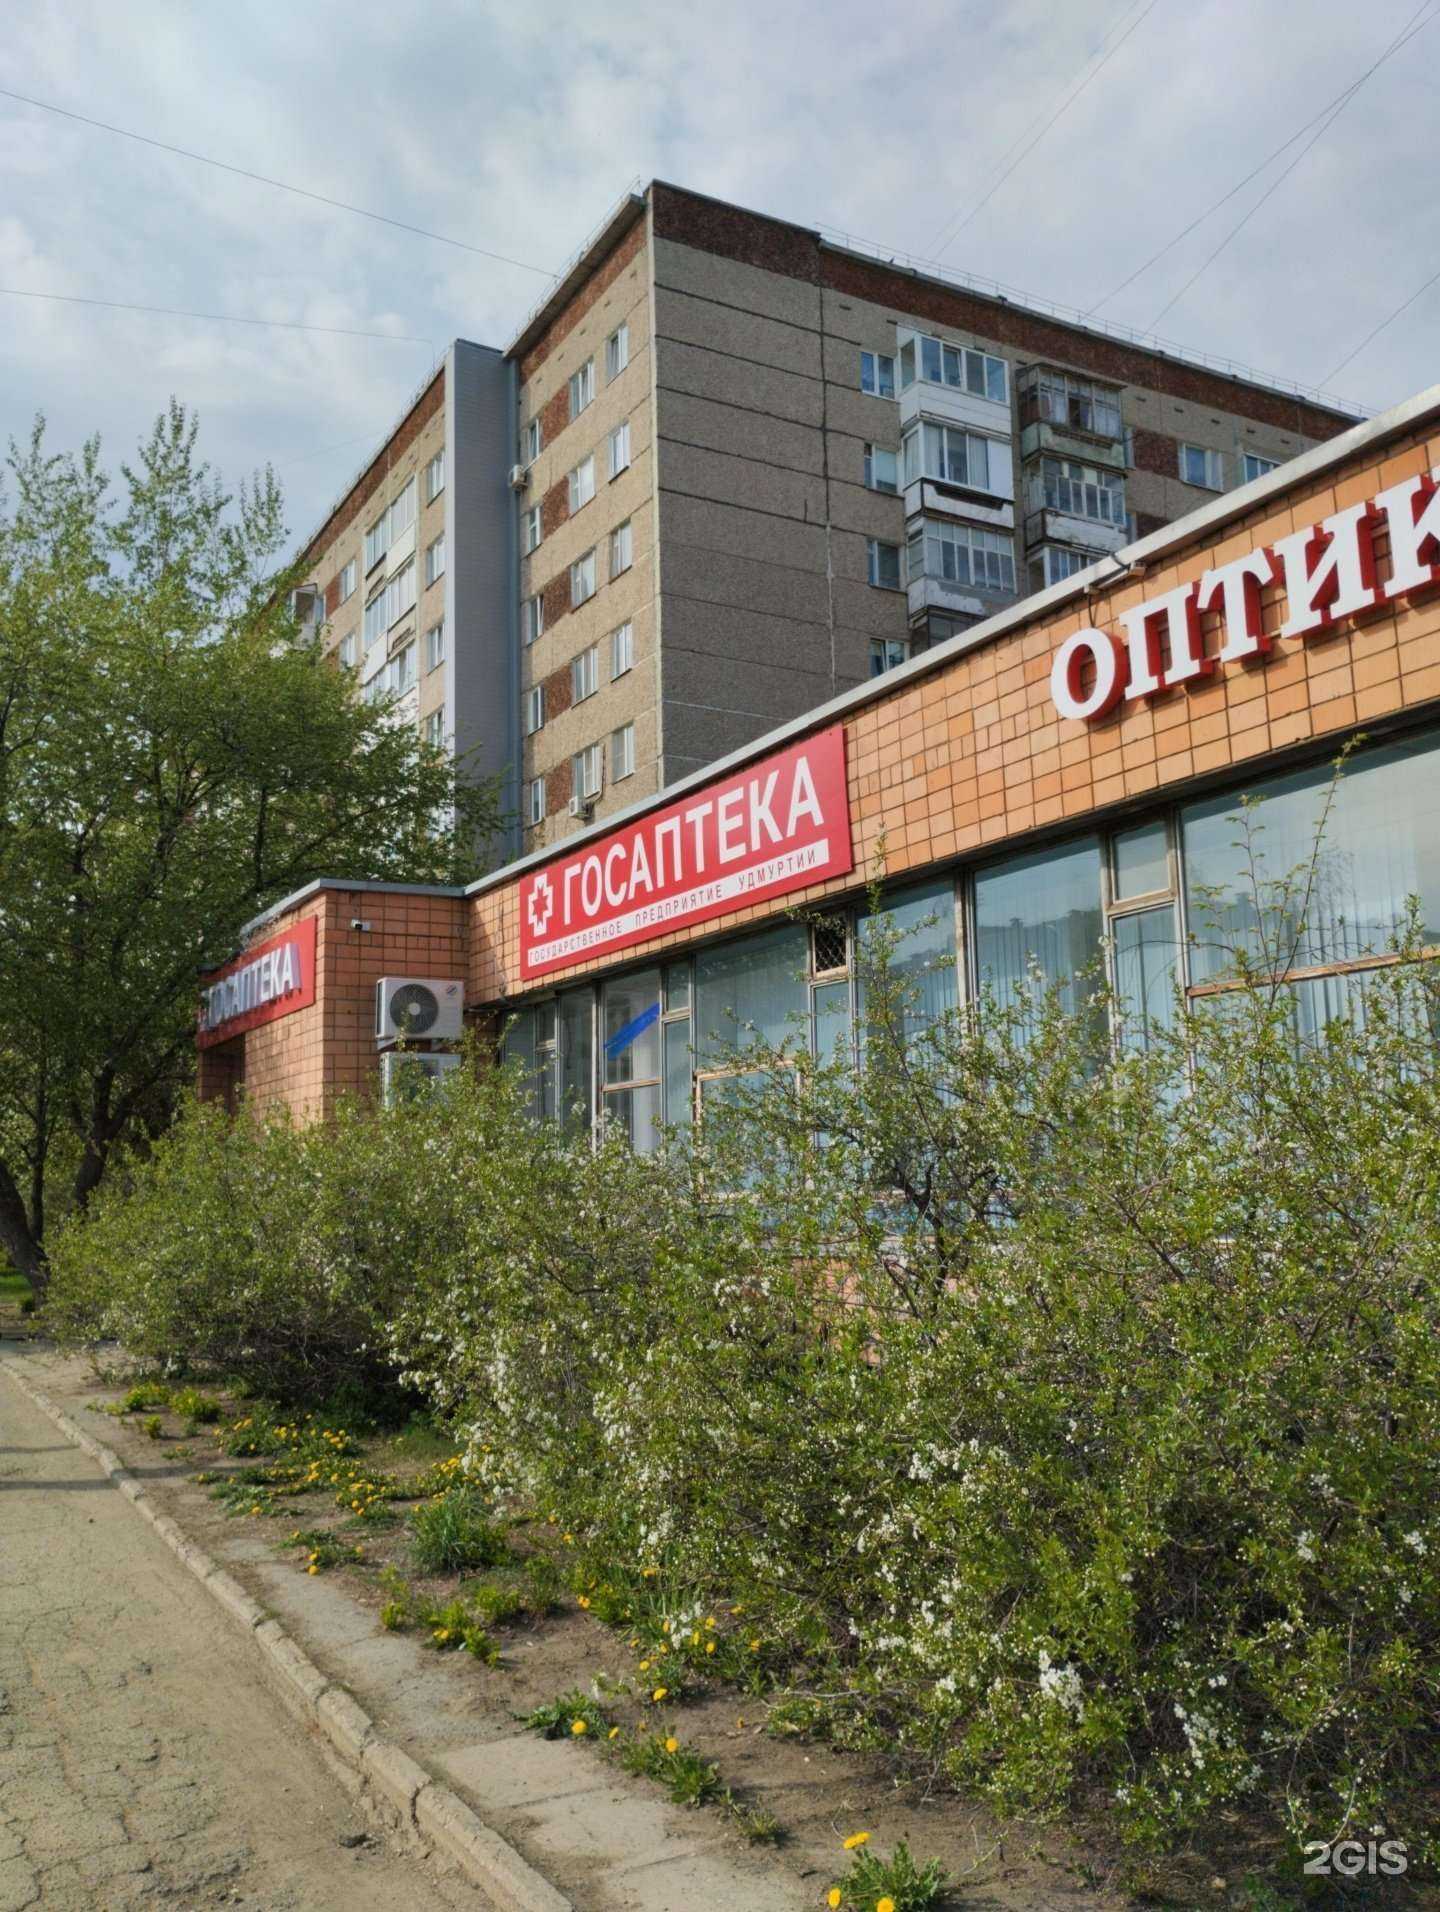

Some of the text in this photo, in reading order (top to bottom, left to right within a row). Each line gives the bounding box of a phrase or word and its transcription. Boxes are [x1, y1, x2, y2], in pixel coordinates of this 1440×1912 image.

[530, 848, 817, 963] ГОСУДАРСТВЕННОЕ ПРЕДПРИЯТИЕ УДМУРТИИ
[563, 755, 825, 925] ГОСАПТЕКА
